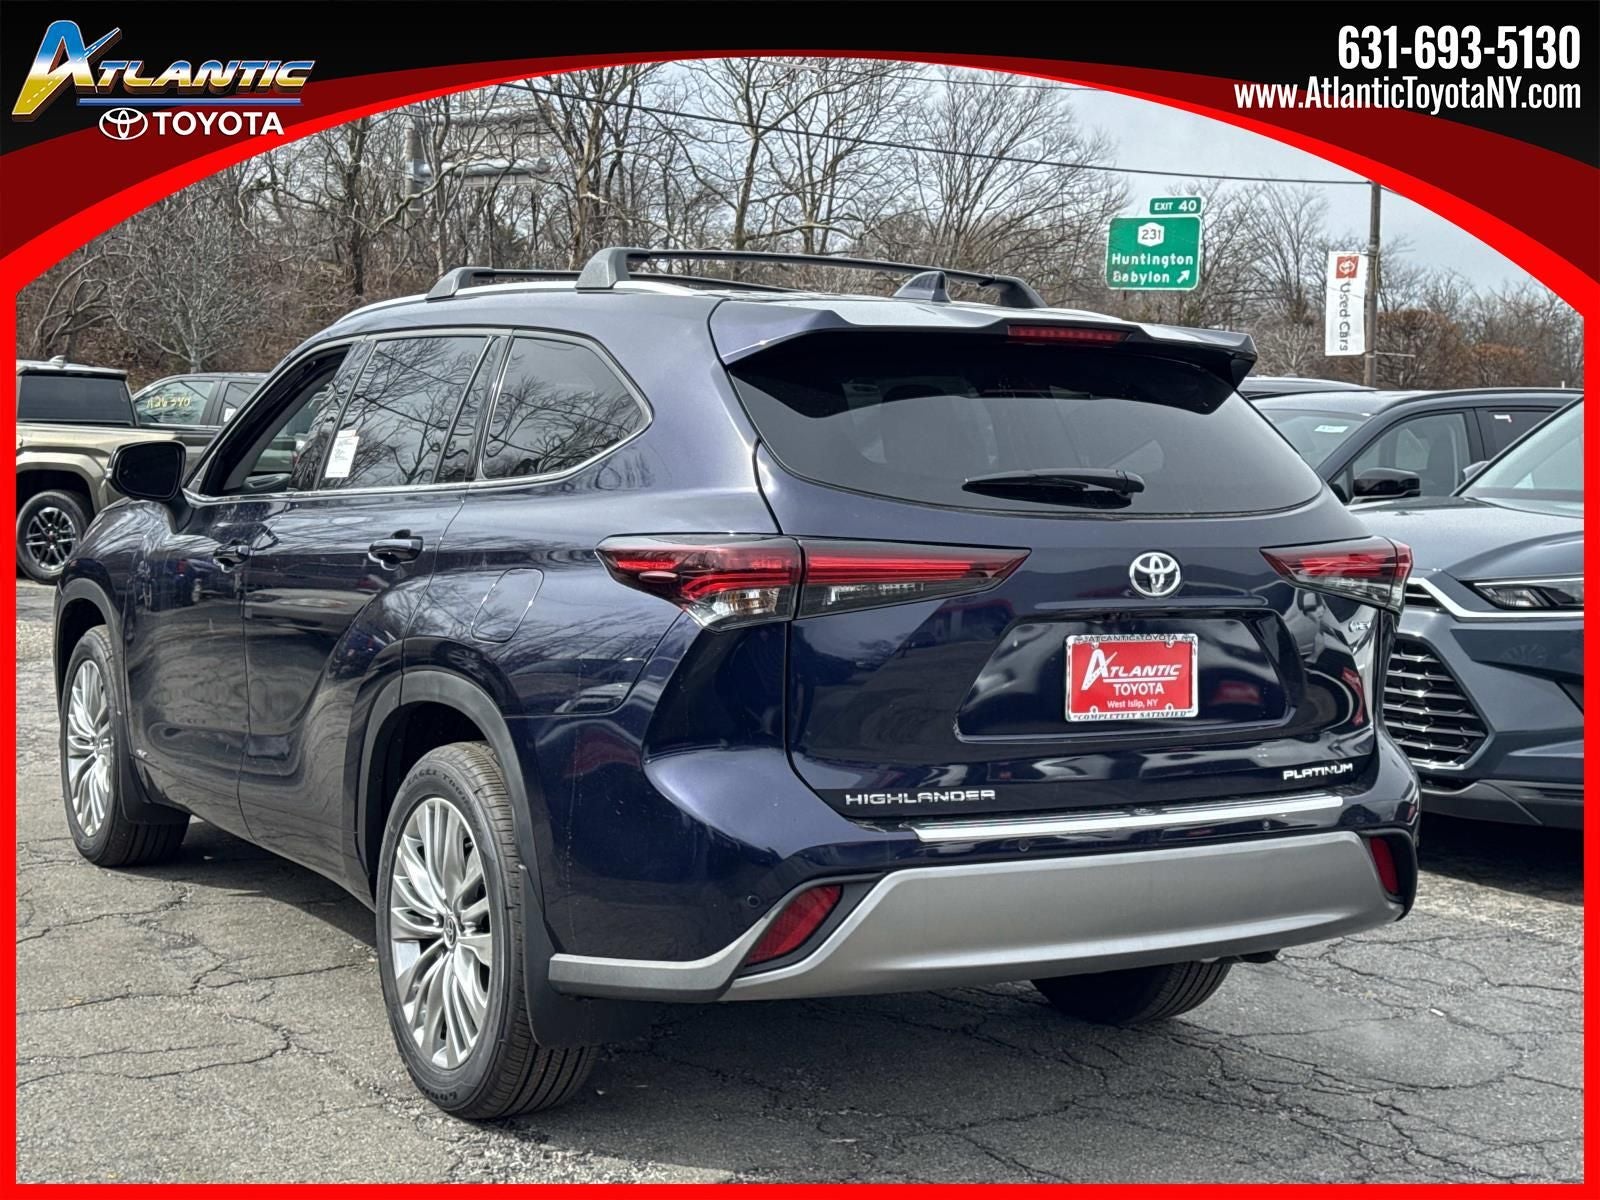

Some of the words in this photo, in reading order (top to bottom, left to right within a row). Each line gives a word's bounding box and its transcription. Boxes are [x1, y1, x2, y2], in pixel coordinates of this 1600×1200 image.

[1154, 202, 1173, 211] EXIT
[1179, 200, 1197, 211] 40
[1141, 229, 1161, 240] 231
[1112, 253, 1194, 269] Huntington
[1113, 270, 1170, 286] Babylon
[1339, 282, 1351, 318] Used
[1339, 321, 1351, 351] Cars
[1139, 633, 1178, 641] TOYOTA
[1081, 649, 1182, 691] ATLANTIC
[1113, 683, 1165, 696] TOYOTA
[1107, 700, 1127, 709] West
[1146, 698, 1159, 707] NY
[1283, 763, 1354, 780] PLATINUM
[845, 789, 996, 805] HIGHLANDER
